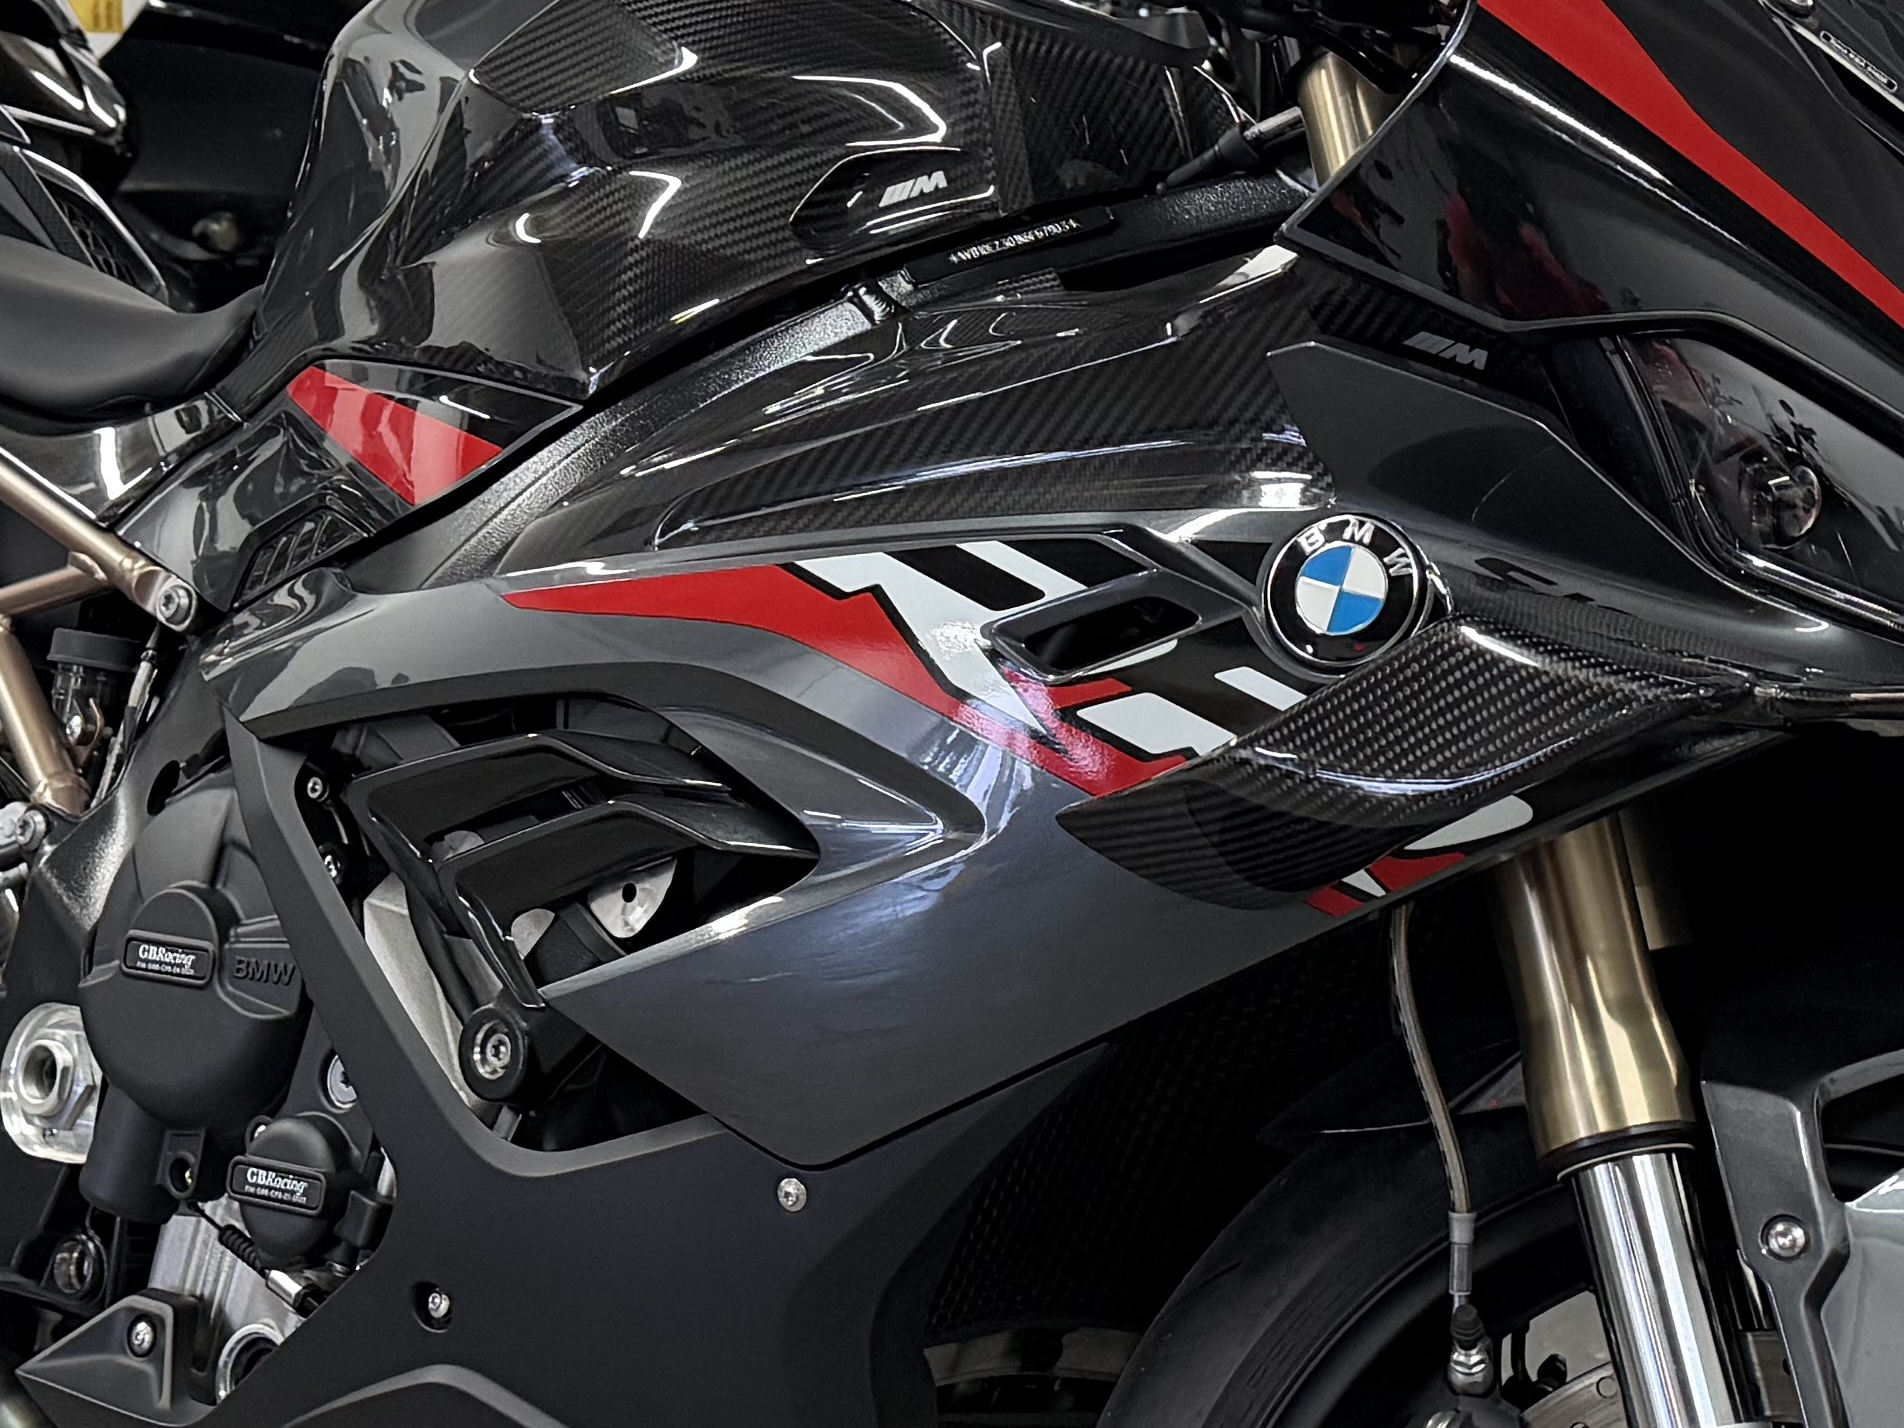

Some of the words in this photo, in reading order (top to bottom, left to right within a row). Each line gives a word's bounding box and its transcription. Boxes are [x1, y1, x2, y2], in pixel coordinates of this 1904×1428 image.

[1296, 519, 1414, 578] BMW
[233, 955, 296, 987] BMW
[246, 1166, 309, 1197] GBRacing
